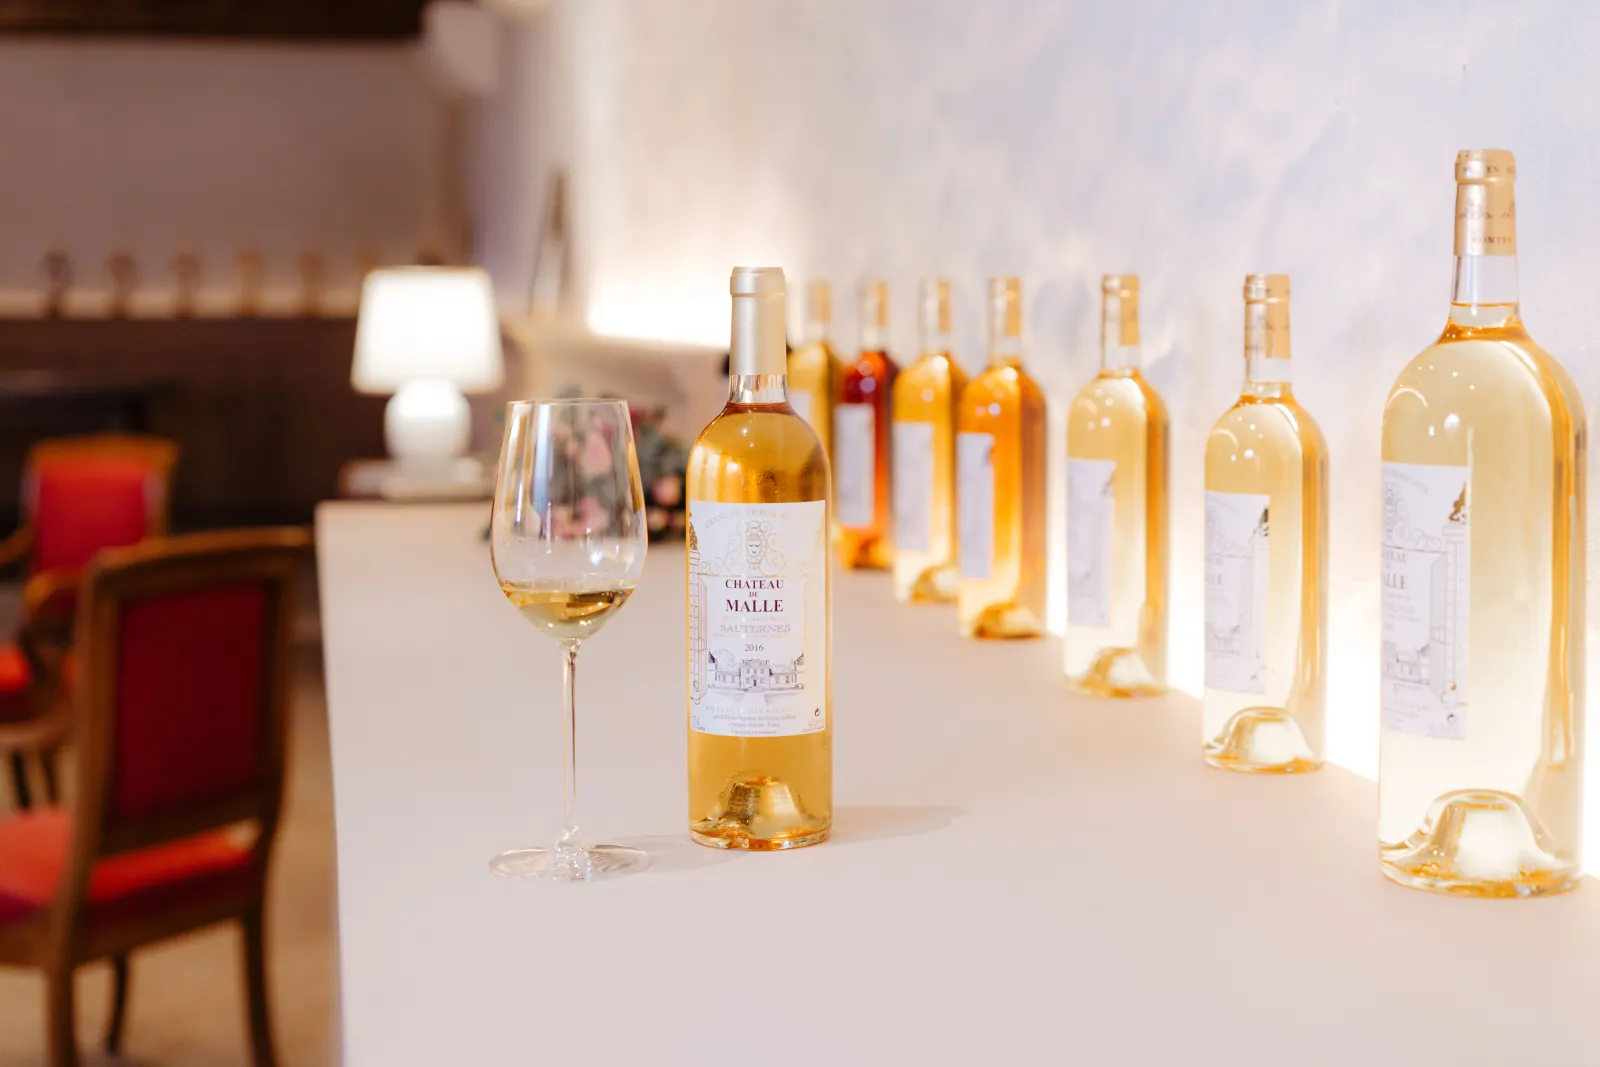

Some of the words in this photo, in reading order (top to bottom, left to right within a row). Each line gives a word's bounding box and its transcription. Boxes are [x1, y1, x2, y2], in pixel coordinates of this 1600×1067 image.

[725, 579, 784, 590] CHATEAU
[725, 599, 784, 613] MALLE
[720, 624, 791, 635] SAUTERNES
[744, 644, 764, 652] 2016
